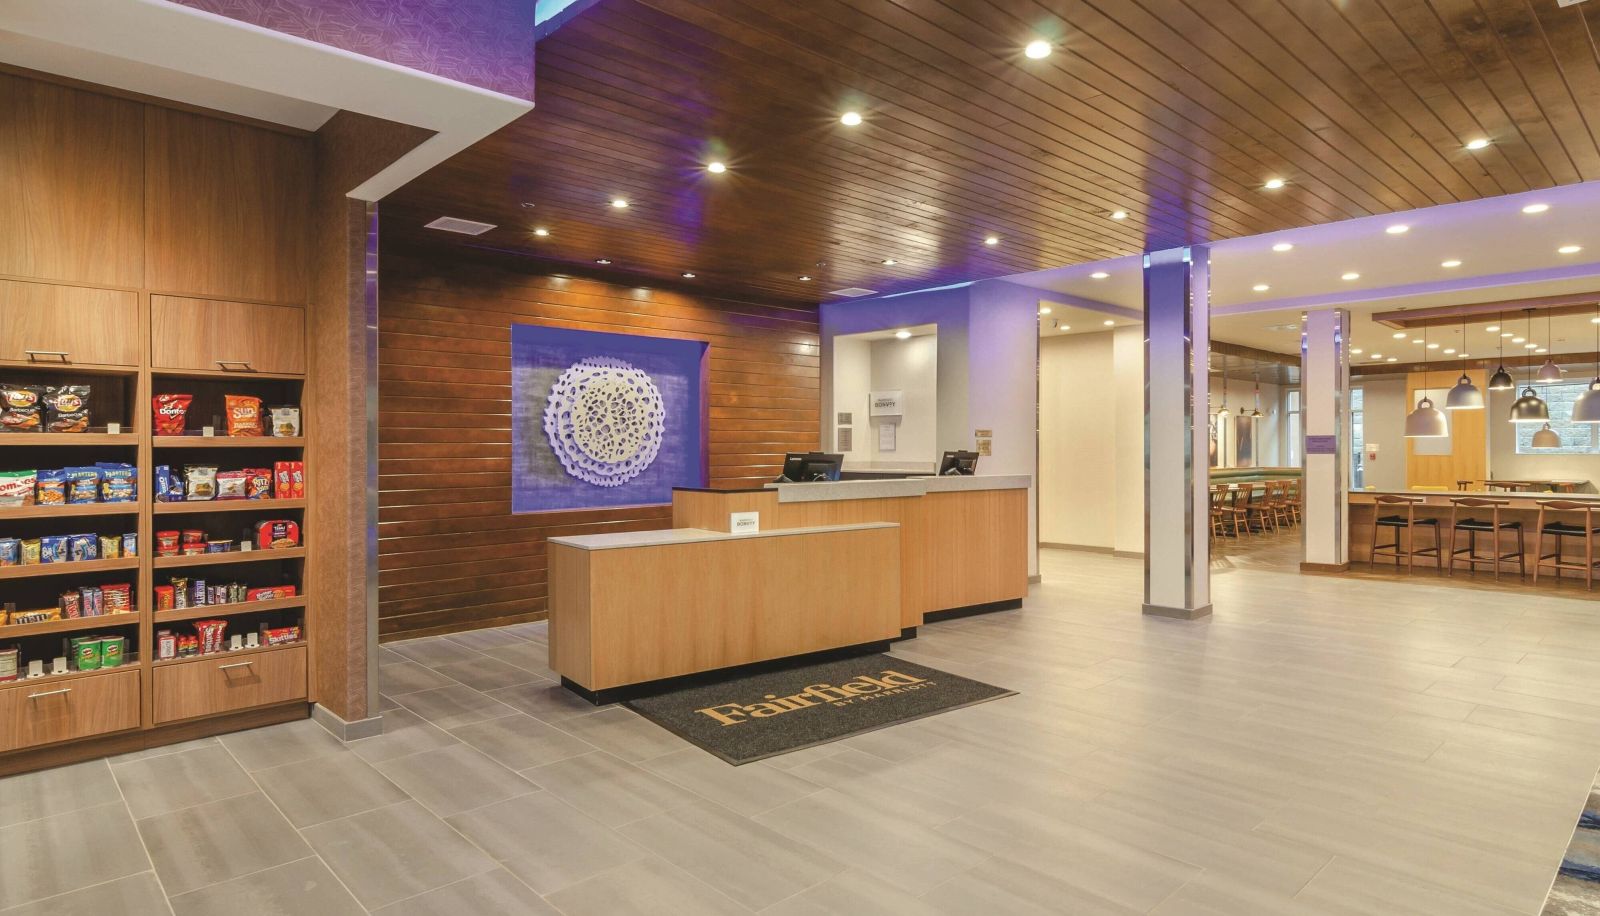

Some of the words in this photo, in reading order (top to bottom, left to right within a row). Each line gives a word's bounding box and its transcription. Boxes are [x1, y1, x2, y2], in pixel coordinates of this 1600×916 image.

[694, 670, 928, 727] Fairfield
[833, 699, 853, 707] BY
[860, 681, 937, 701] MARRIOTT
